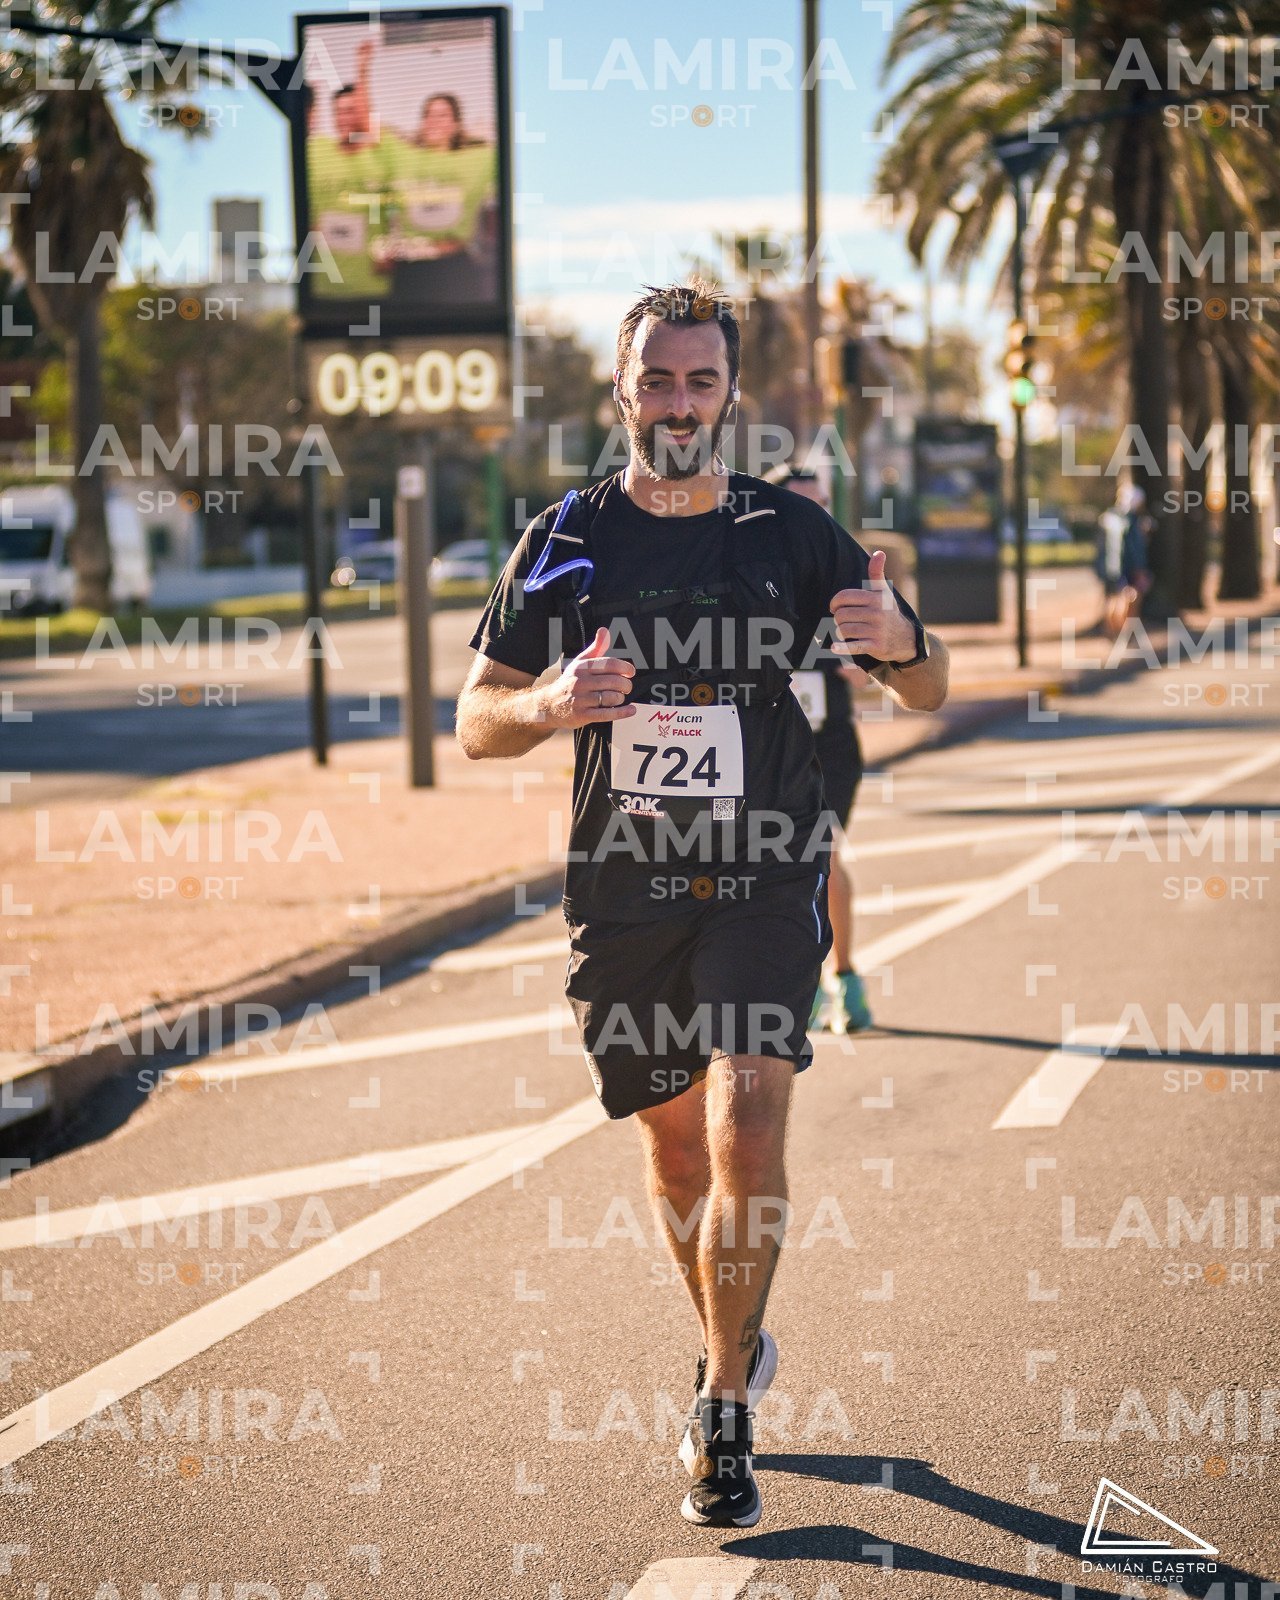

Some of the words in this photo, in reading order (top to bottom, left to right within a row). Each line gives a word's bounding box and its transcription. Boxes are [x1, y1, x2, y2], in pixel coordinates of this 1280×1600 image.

[318, 349, 499, 416] 09:09
[676, 715, 703, 723] ucm
[672, 728, 702, 737] FALCK
[632, 743, 721, 788] 724
[619, 794, 661, 813] 30K
